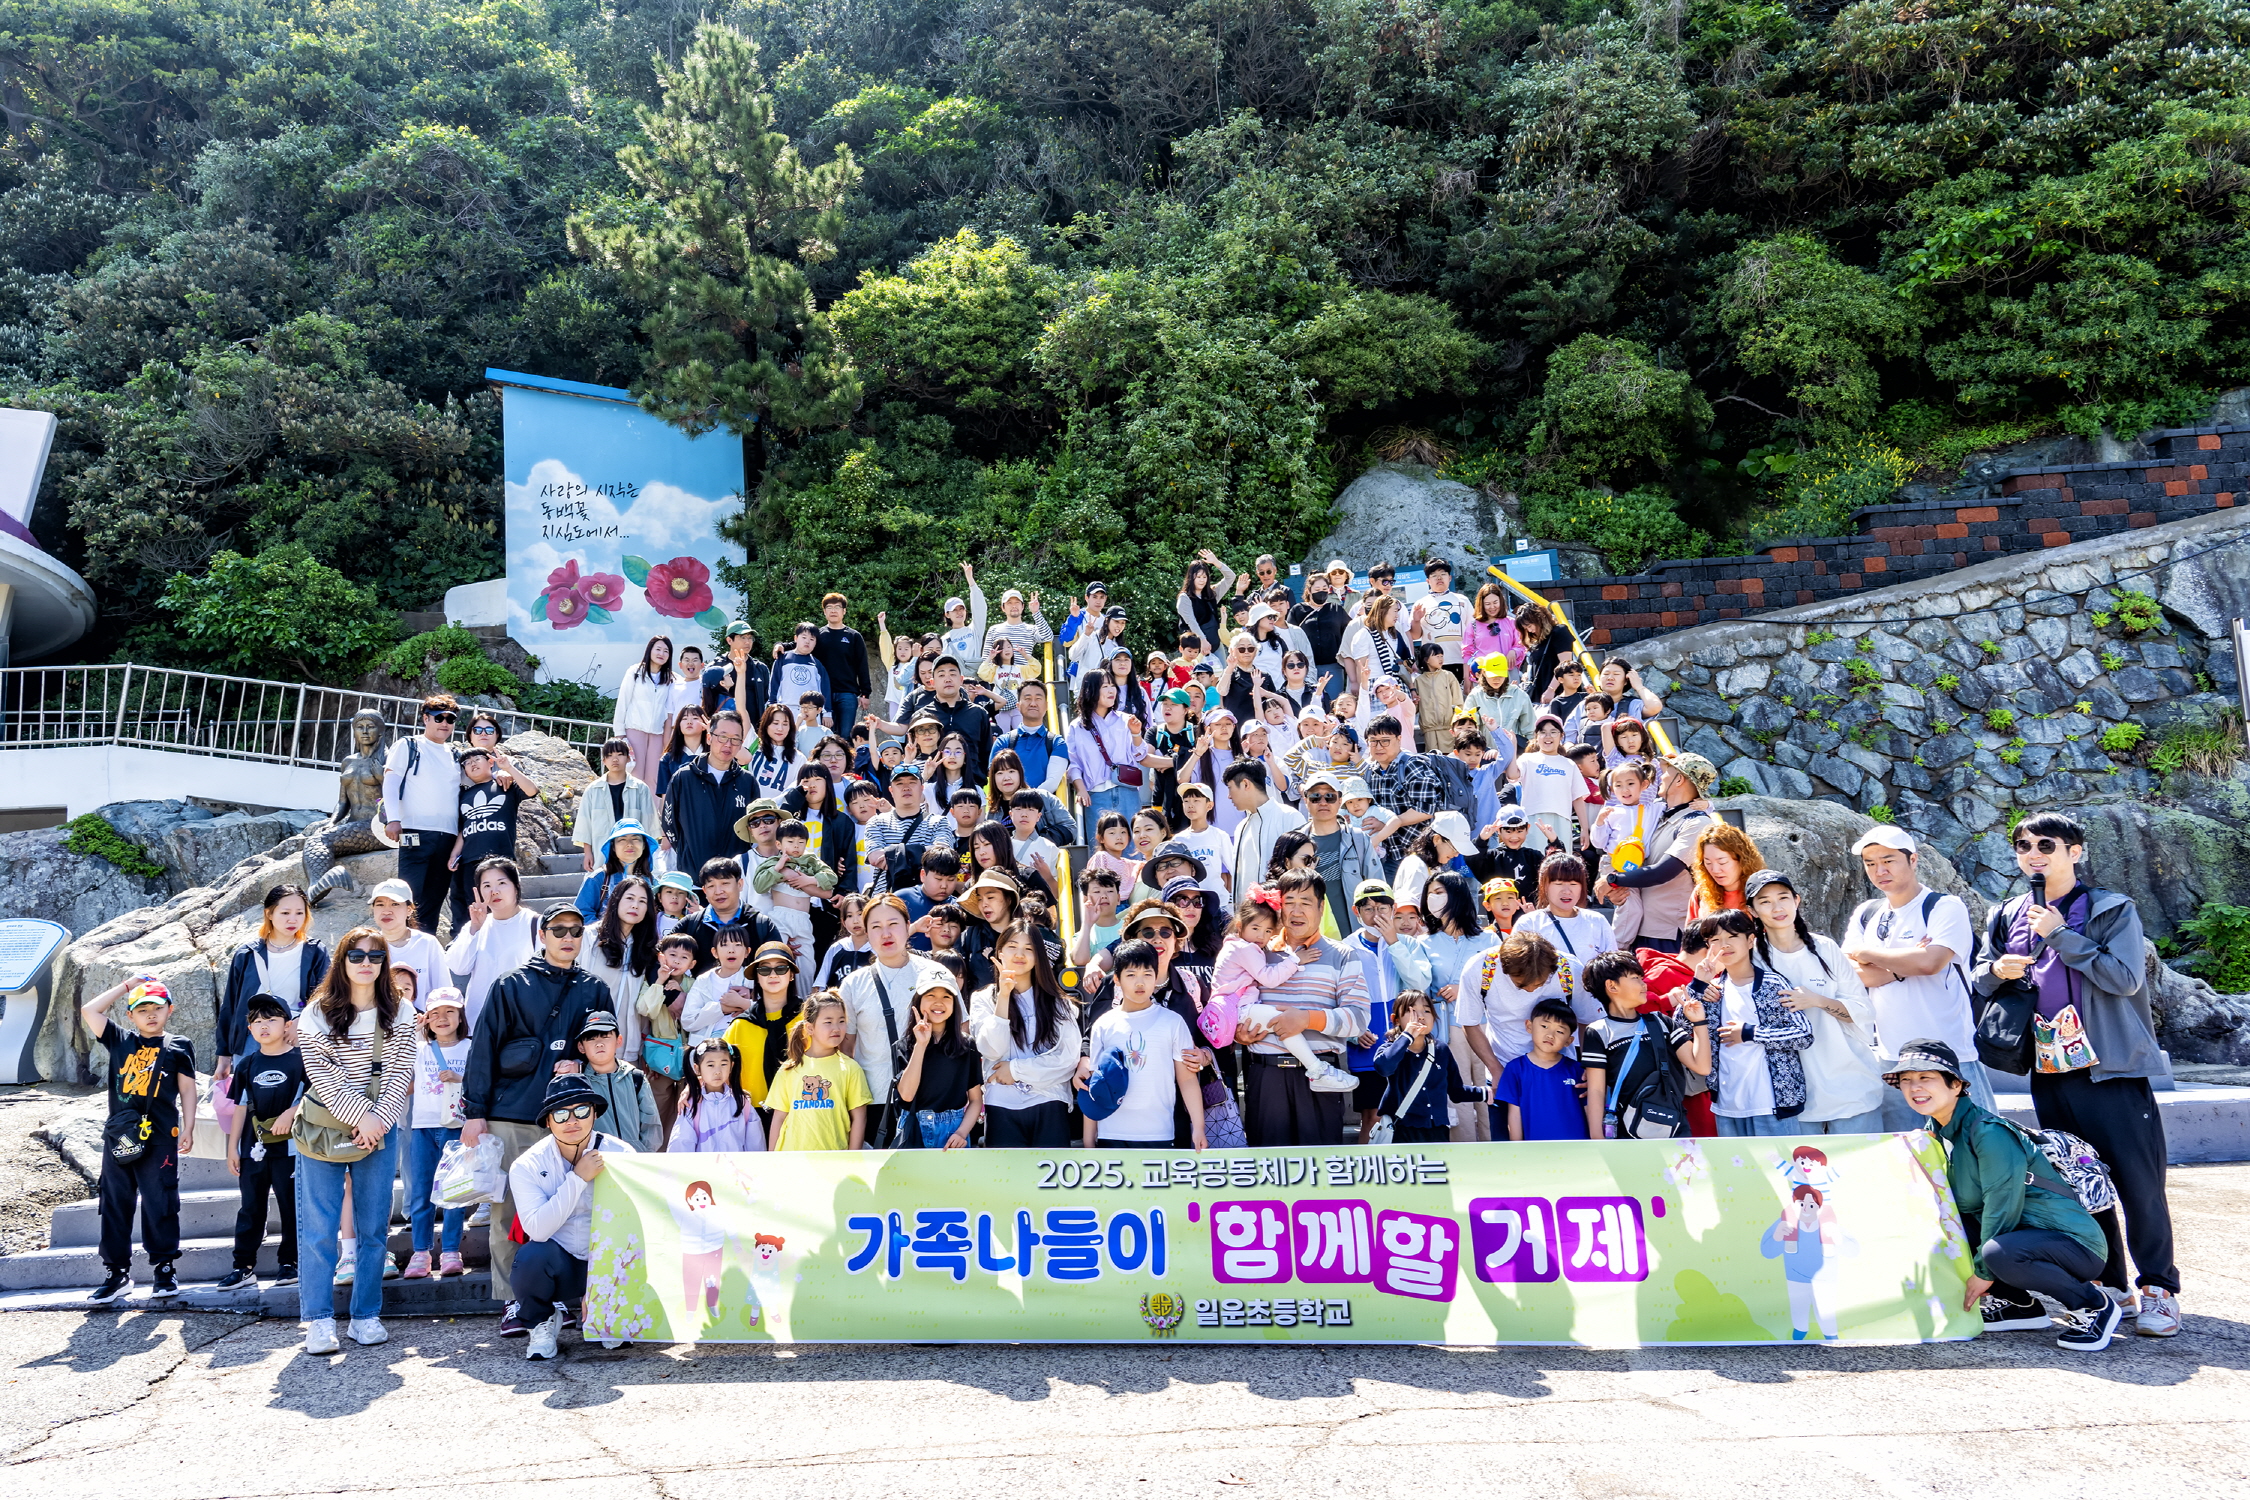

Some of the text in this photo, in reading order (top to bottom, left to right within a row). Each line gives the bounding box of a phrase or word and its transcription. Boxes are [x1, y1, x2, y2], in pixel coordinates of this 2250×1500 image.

[540, 481, 639, 499] 사랑의 시작은
[541, 501, 590, 522] 동백꽃
[541, 523, 630, 542] 지심도에서...
[752, 751, 788, 792] USA
[462, 819, 507, 839] adidas
[1036, 1153, 1448, 1189] 2025. 교육공동체가 함께하는
[845, 1206, 1169, 1283] 가족나들이
[1194, 1298, 1352, 1327] 일운초등학교
